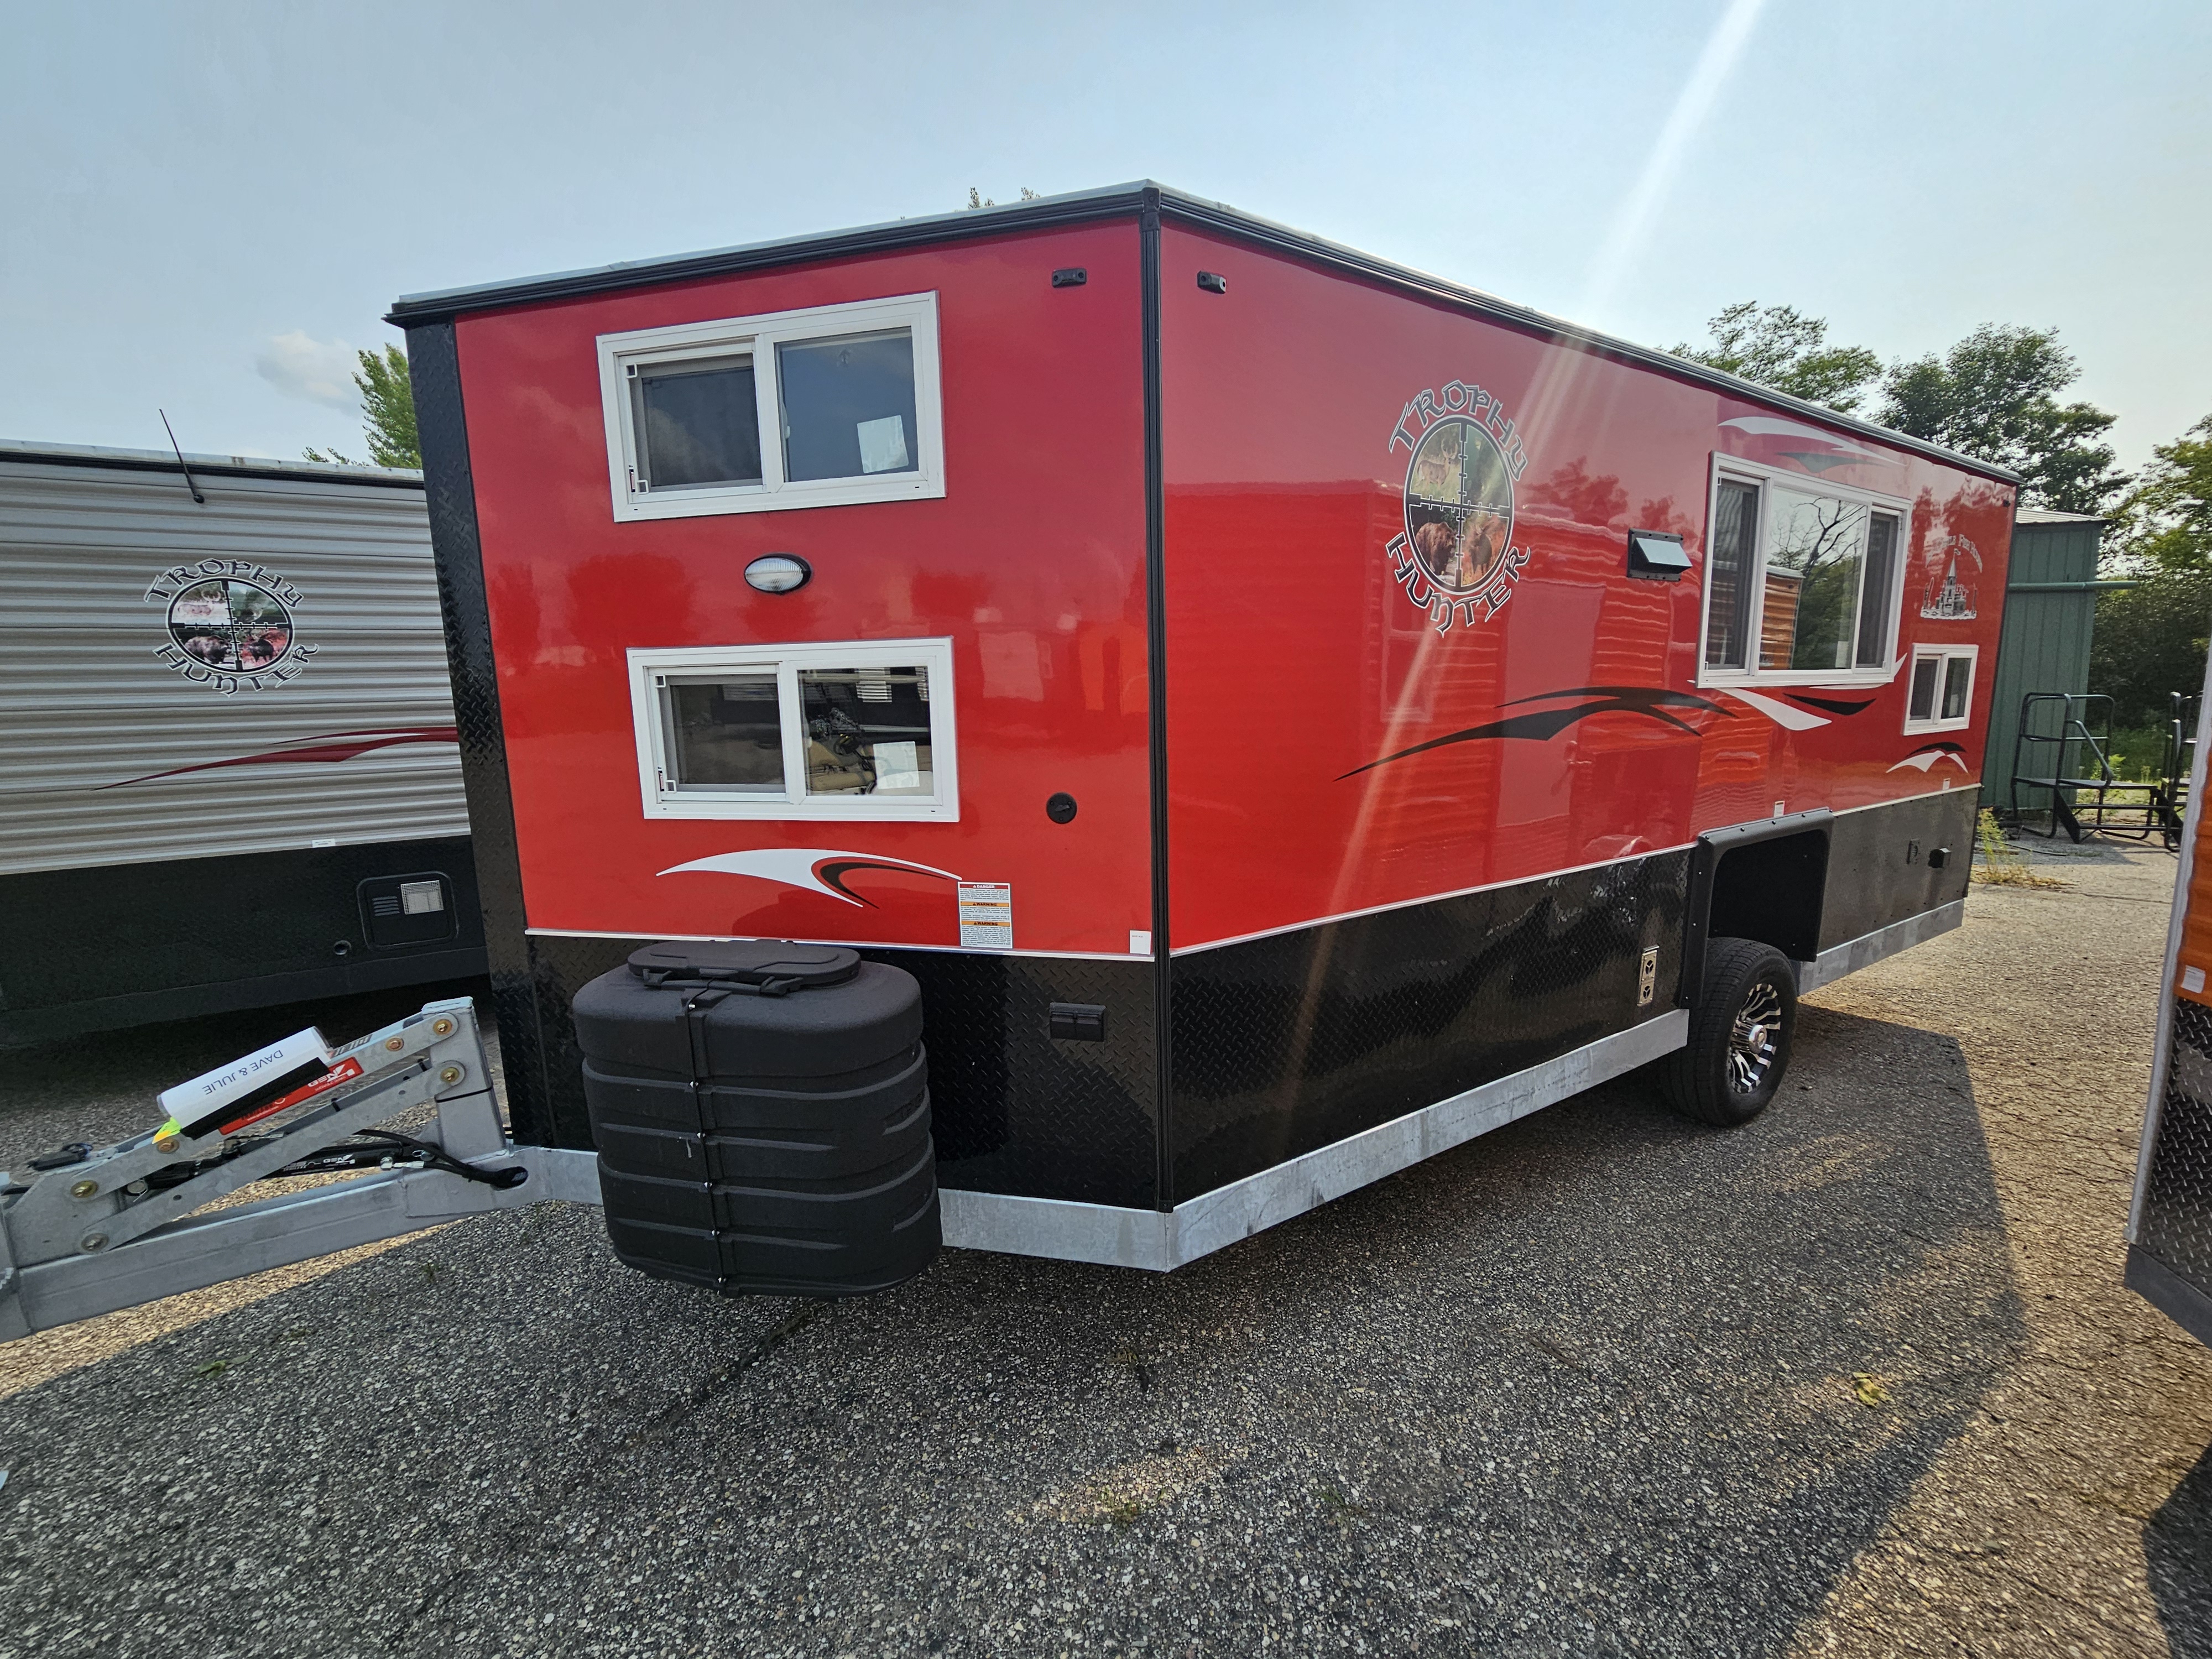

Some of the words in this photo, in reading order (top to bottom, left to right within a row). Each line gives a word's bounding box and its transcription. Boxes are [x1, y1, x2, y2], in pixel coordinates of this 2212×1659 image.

[1389, 379, 1528, 482] TROPHY
[143, 557, 304, 608] TROPHY
[1385, 531, 1531, 639] HUNTER
[152, 643, 320, 698] HUNTER
[202, 1072, 236, 1095] JULIE
[238, 1067, 248, 1076] &
[249, 1050, 284, 1072] DAVE
